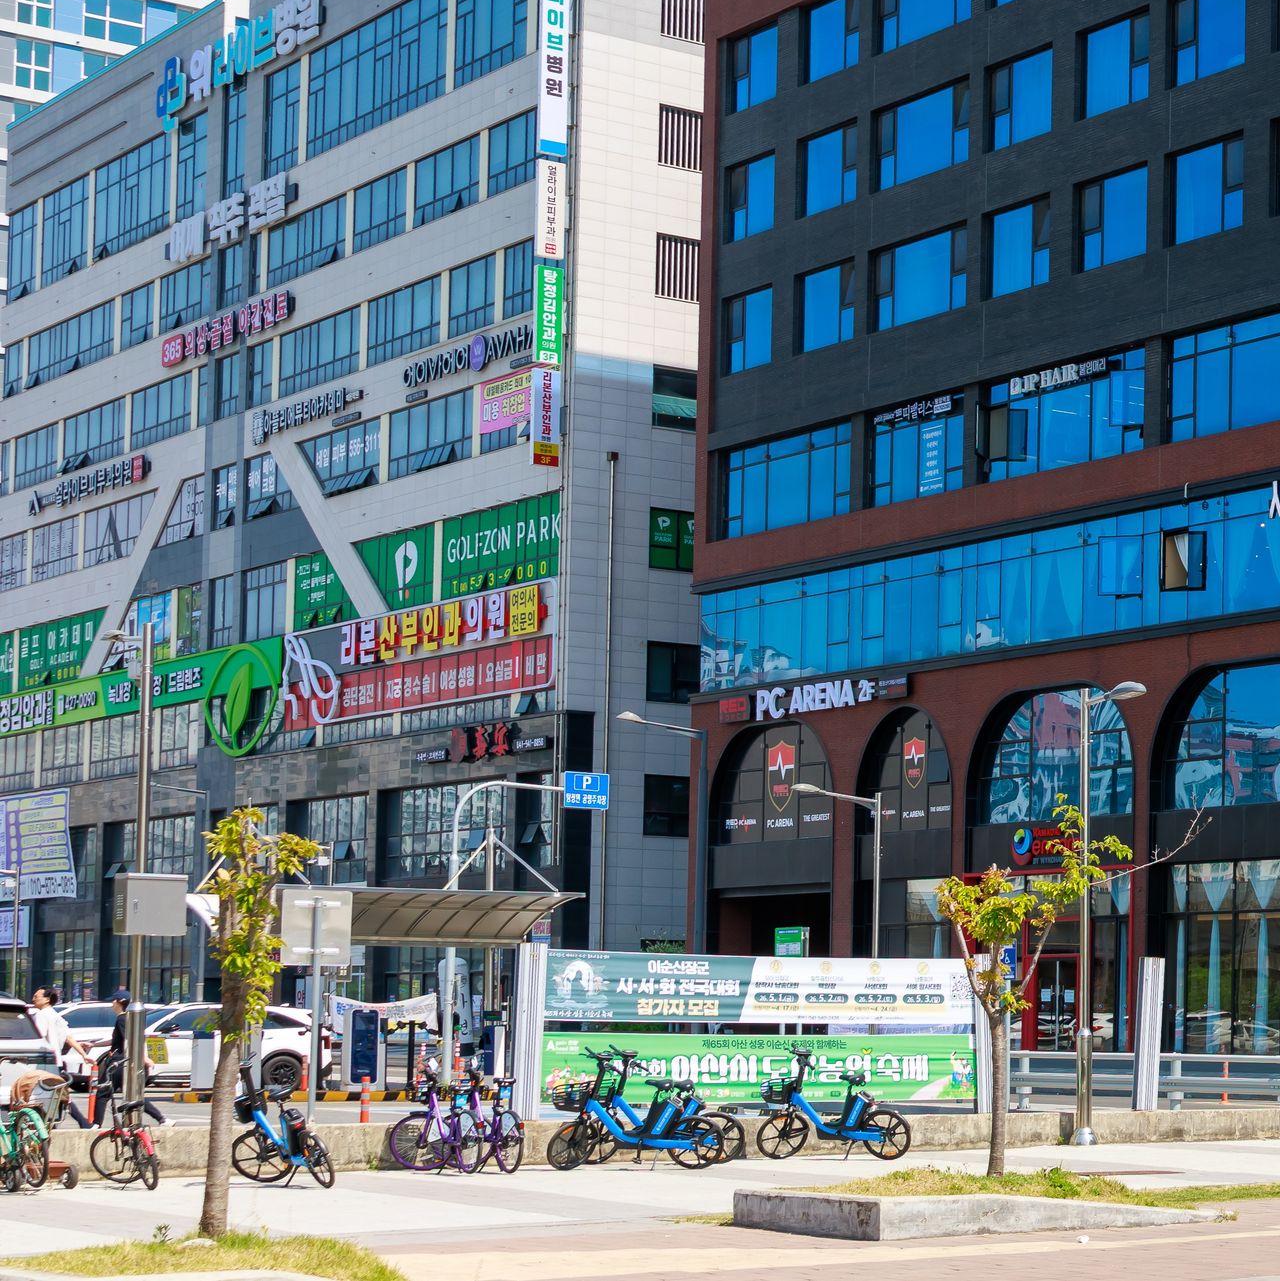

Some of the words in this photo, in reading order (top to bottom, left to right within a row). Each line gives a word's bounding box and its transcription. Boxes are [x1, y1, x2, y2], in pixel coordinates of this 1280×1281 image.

[546, 165, 557, 237] 얼라이브피부과
[542, 270, 557, 342] 탕정김안과
[163, 338, 182, 363] 365
[239, 291, 289, 336] 야간진료
[542, 352, 555, 362] 3F
[1022, 373, 1040, 393] JP
[1040, 364, 1080, 388] HAIR
[483, 401, 499, 422] 미용
[542, 371, 552, 436] 리본산부인과
[540, 456, 551, 464] 3F
[446, 524, 512, 564] GOLFZON
[516, 511, 560, 547] PARK
[511, 589, 536, 608] 여의사
[340, 591, 506, 666] 리본산부인과의원
[511, 612, 536, 632] 전문의
[20, 634, 41, 658] 골프
[47, 620, 94, 650] 아카데미
[29, 657, 43, 670] GOLF
[50, 649, 78, 666] ACADEMY
[168, 667, 203, 692] 드림렌즈
[343, 682, 374, 707] 공단검진
[440, 664, 475, 690] 여성성형
[485, 659, 512, 681] 요실금
[525, 652, 547, 676] 비만
[108, 681, 133, 705] 녹내장
[720, 697, 747, 713] RED
[756, 687, 787, 721] PC
[789, 679, 856, 714] ARENA
[858, 679, 876, 702] 2F
[582, 776, 592, 789] P
[767, 818, 776, 828] PC
[775, 817, 793, 828] ARENA
[803, 814, 811, 822] THE
[810, 813, 830, 822] GREATEST
[903, 811, 910, 819] PC
[909, 809, 924, 818] ARENA
[648, 960, 710, 975] 이순신장군
[616, 977, 676, 996] 시·서·화
[679, 978, 741, 997] 전국대회
[637, 999, 686, 1016] 참가자
[687, 1000, 720, 1017] 모집
[702, 1040, 729, 1049] 제65회
[731, 1040, 747, 1049] 아산
[749, 1040, 765, 1049] 성웅
[767, 1040, 790, 1050] 이순신
[815, 1040, 847, 1050] 함께하는
[671, 1053, 758, 1084] 아산시
[876, 1053, 929, 1083] 축제
